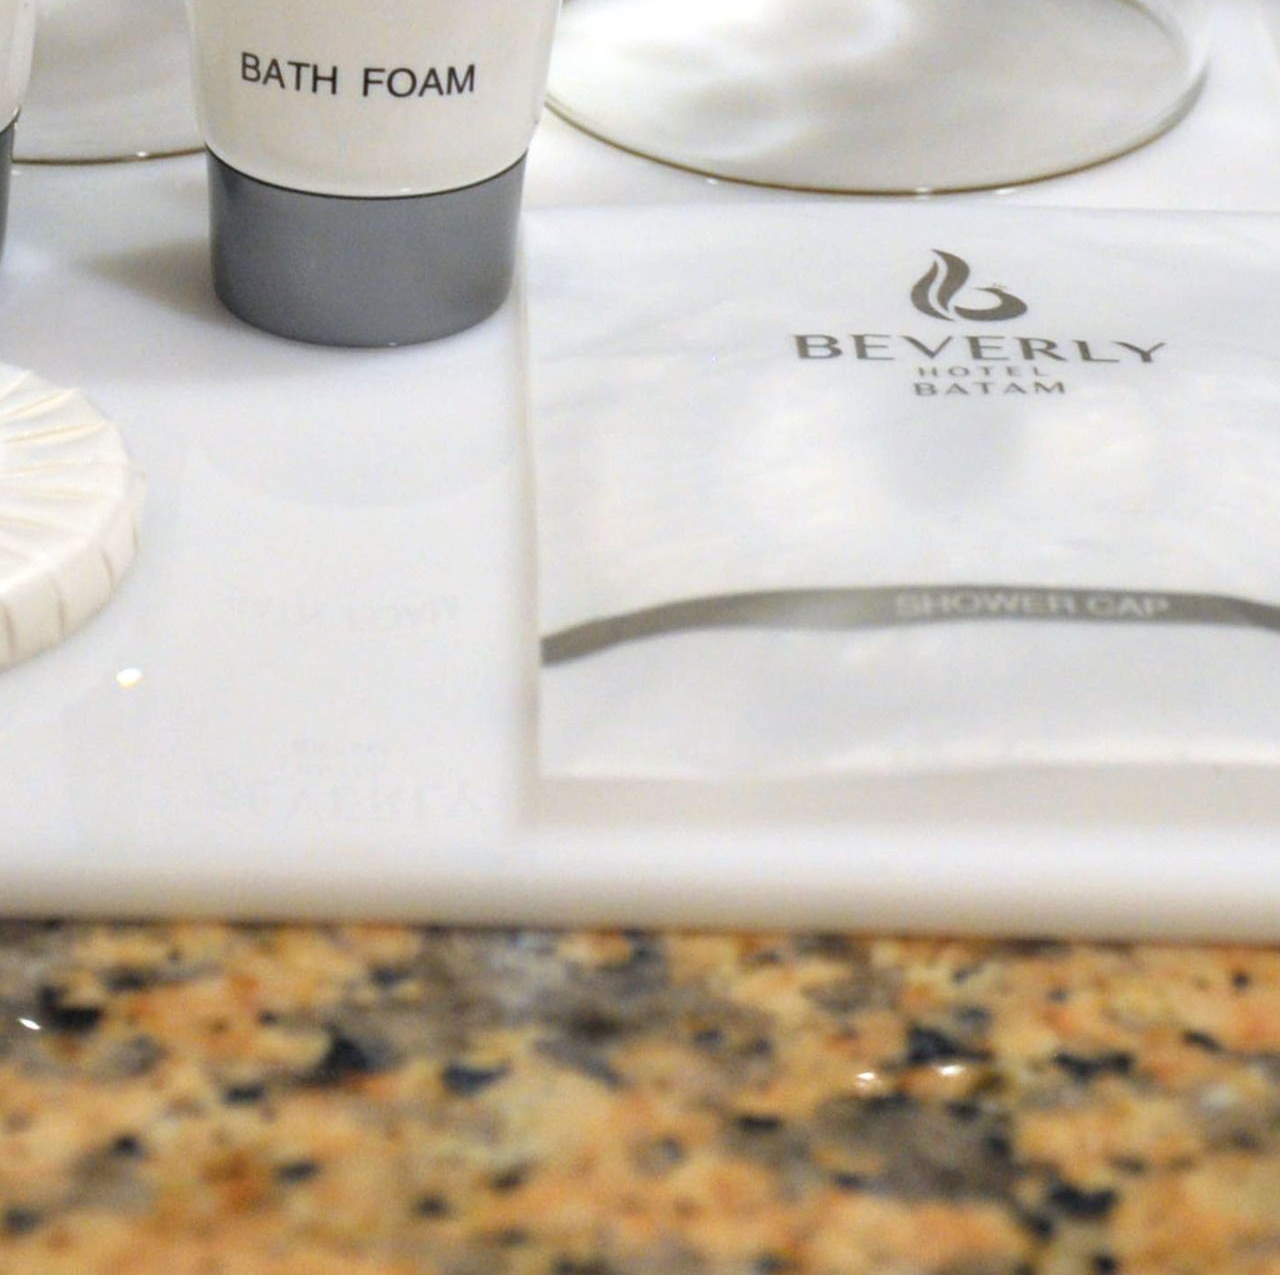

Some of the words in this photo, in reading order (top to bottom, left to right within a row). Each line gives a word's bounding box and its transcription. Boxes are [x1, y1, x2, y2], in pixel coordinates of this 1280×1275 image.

[240, 52, 338, 96] BATH
[362, 64, 477, 98] FOAM
[792, 333, 1167, 364] BEVERLY
[918, 365, 1050, 378] HOTEL
[913, 381, 1066, 397] BATAM
[895, 591, 1077, 619] SHOWER
[1086, 593, 1171, 618] CAP
